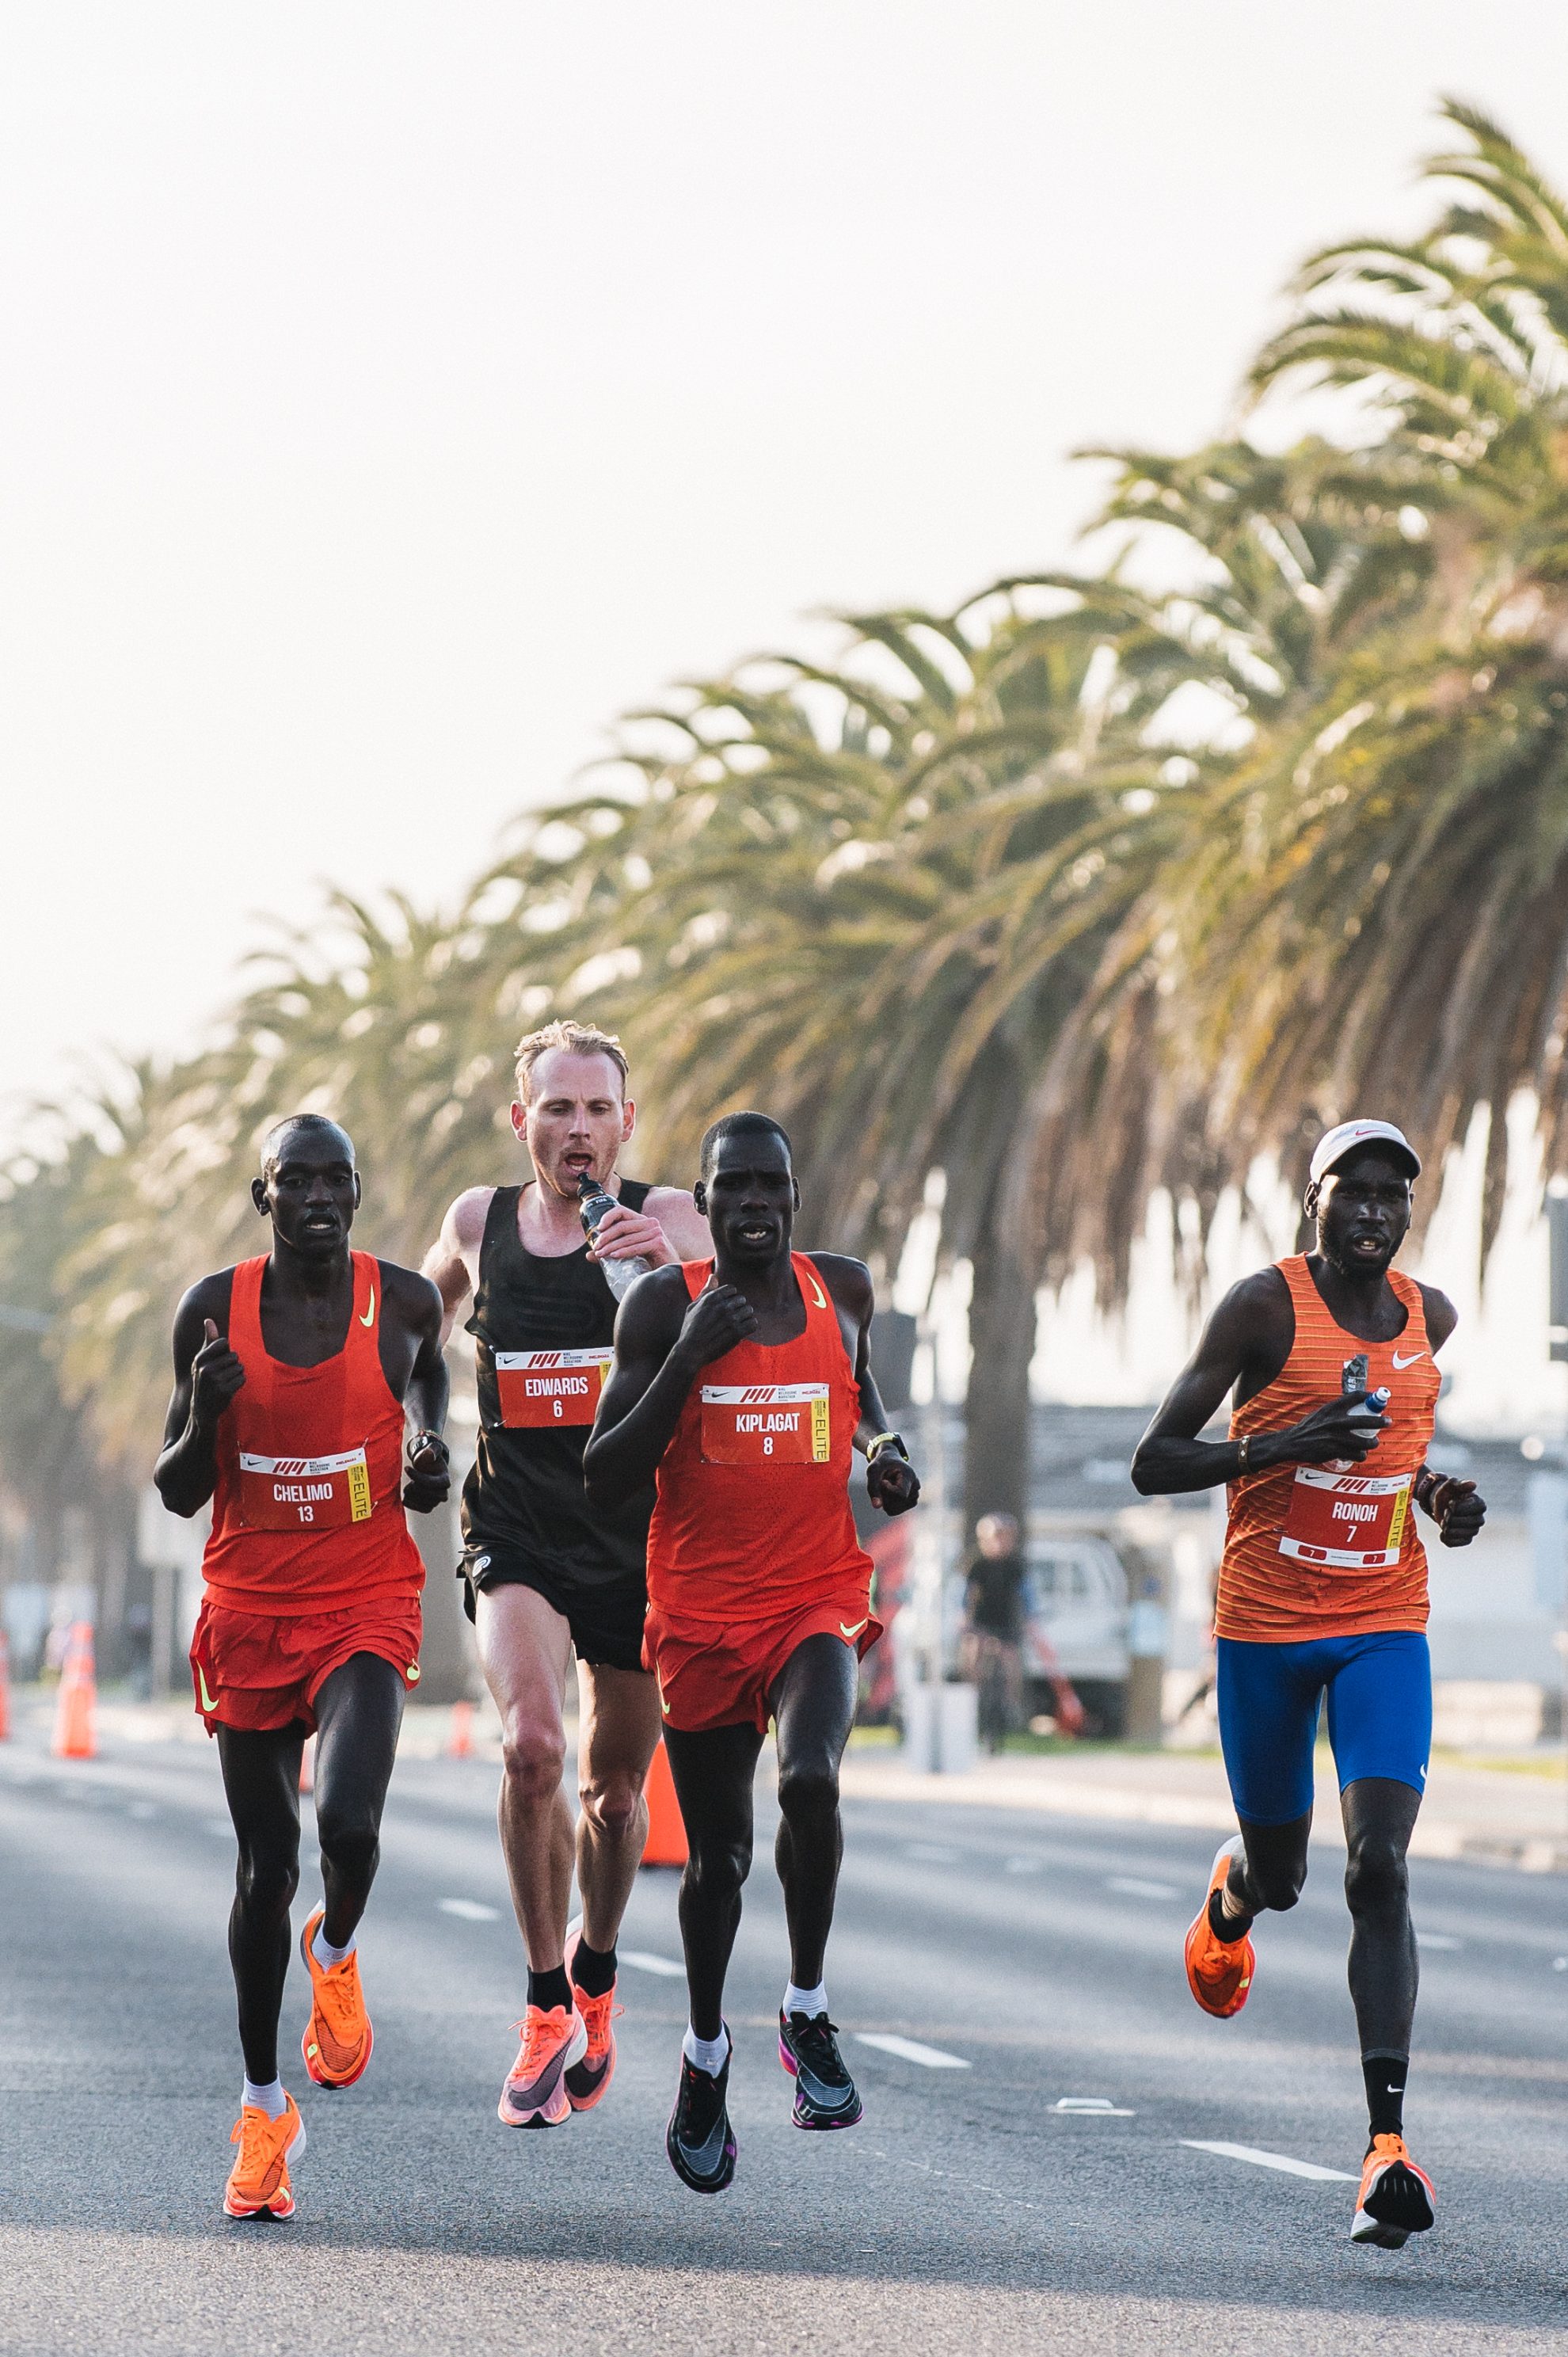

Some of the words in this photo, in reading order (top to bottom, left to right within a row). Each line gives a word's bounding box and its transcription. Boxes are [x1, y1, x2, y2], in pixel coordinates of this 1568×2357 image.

[525, 1377, 588, 1397] EDWARDS
[553, 1399, 563, 1418] 6
[736, 1412, 800, 1433] KIPLAGAT
[763, 1436, 774, 1455] 8
[816, 1419, 827, 1460] ELITE
[273, 1482, 333, 1502] CHELIMO
[353, 1483, 367, 1518] ELITE
[297, 1506, 314, 1522] 13
[1332, 1501, 1379, 1521] RONOH
[1346, 1525, 1357, 1543] 7
[1390, 1508, 1403, 1547] ELITE
